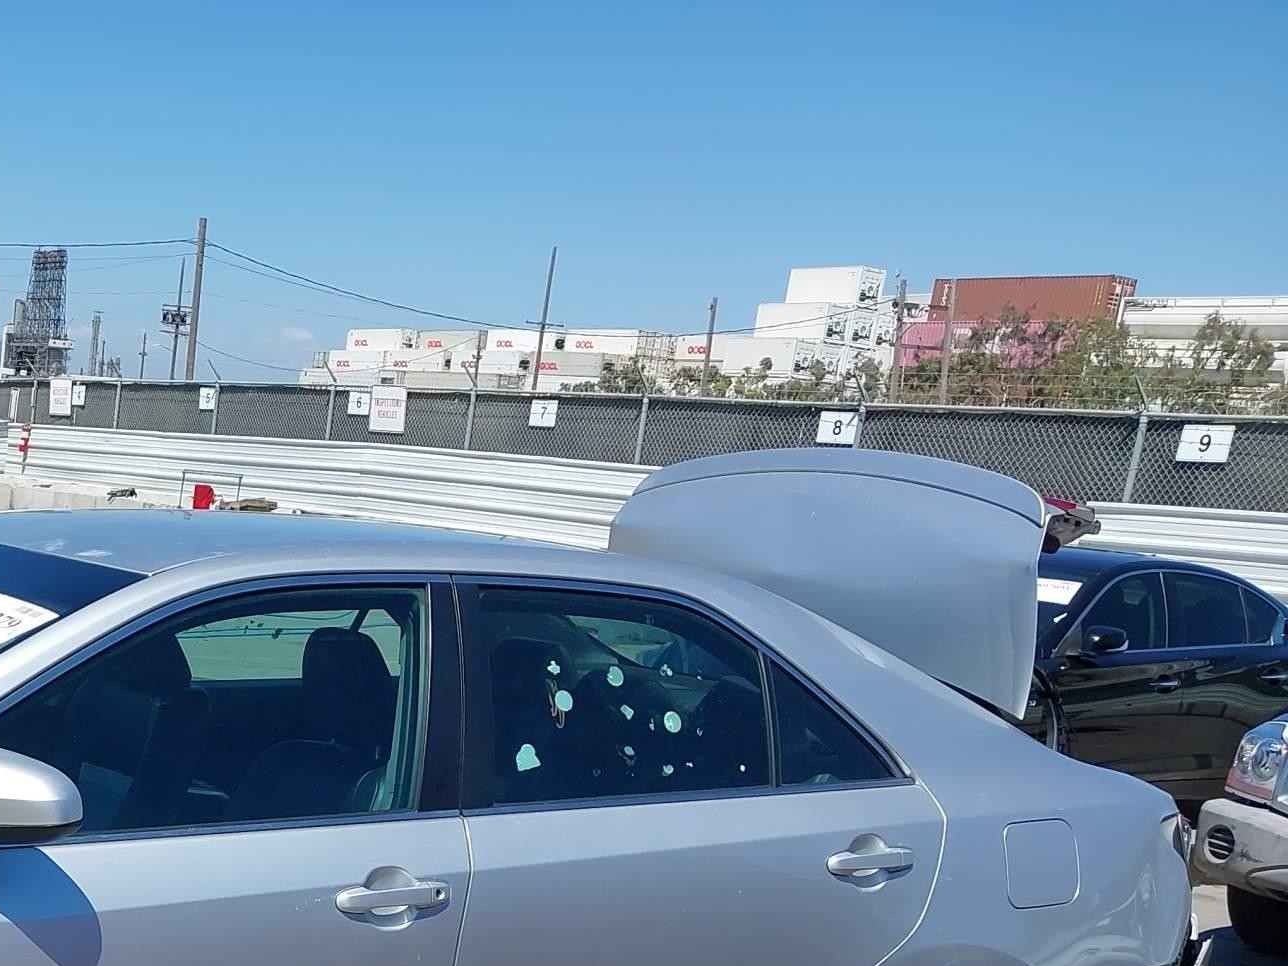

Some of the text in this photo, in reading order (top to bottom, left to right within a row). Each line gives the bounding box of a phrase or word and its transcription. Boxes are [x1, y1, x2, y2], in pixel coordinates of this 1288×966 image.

[356, 396, 363, 409] 6
[541, 406, 548, 420] 7
[832, 419, 843, 436] 8
[1198, 434, 1212, 453] 9
